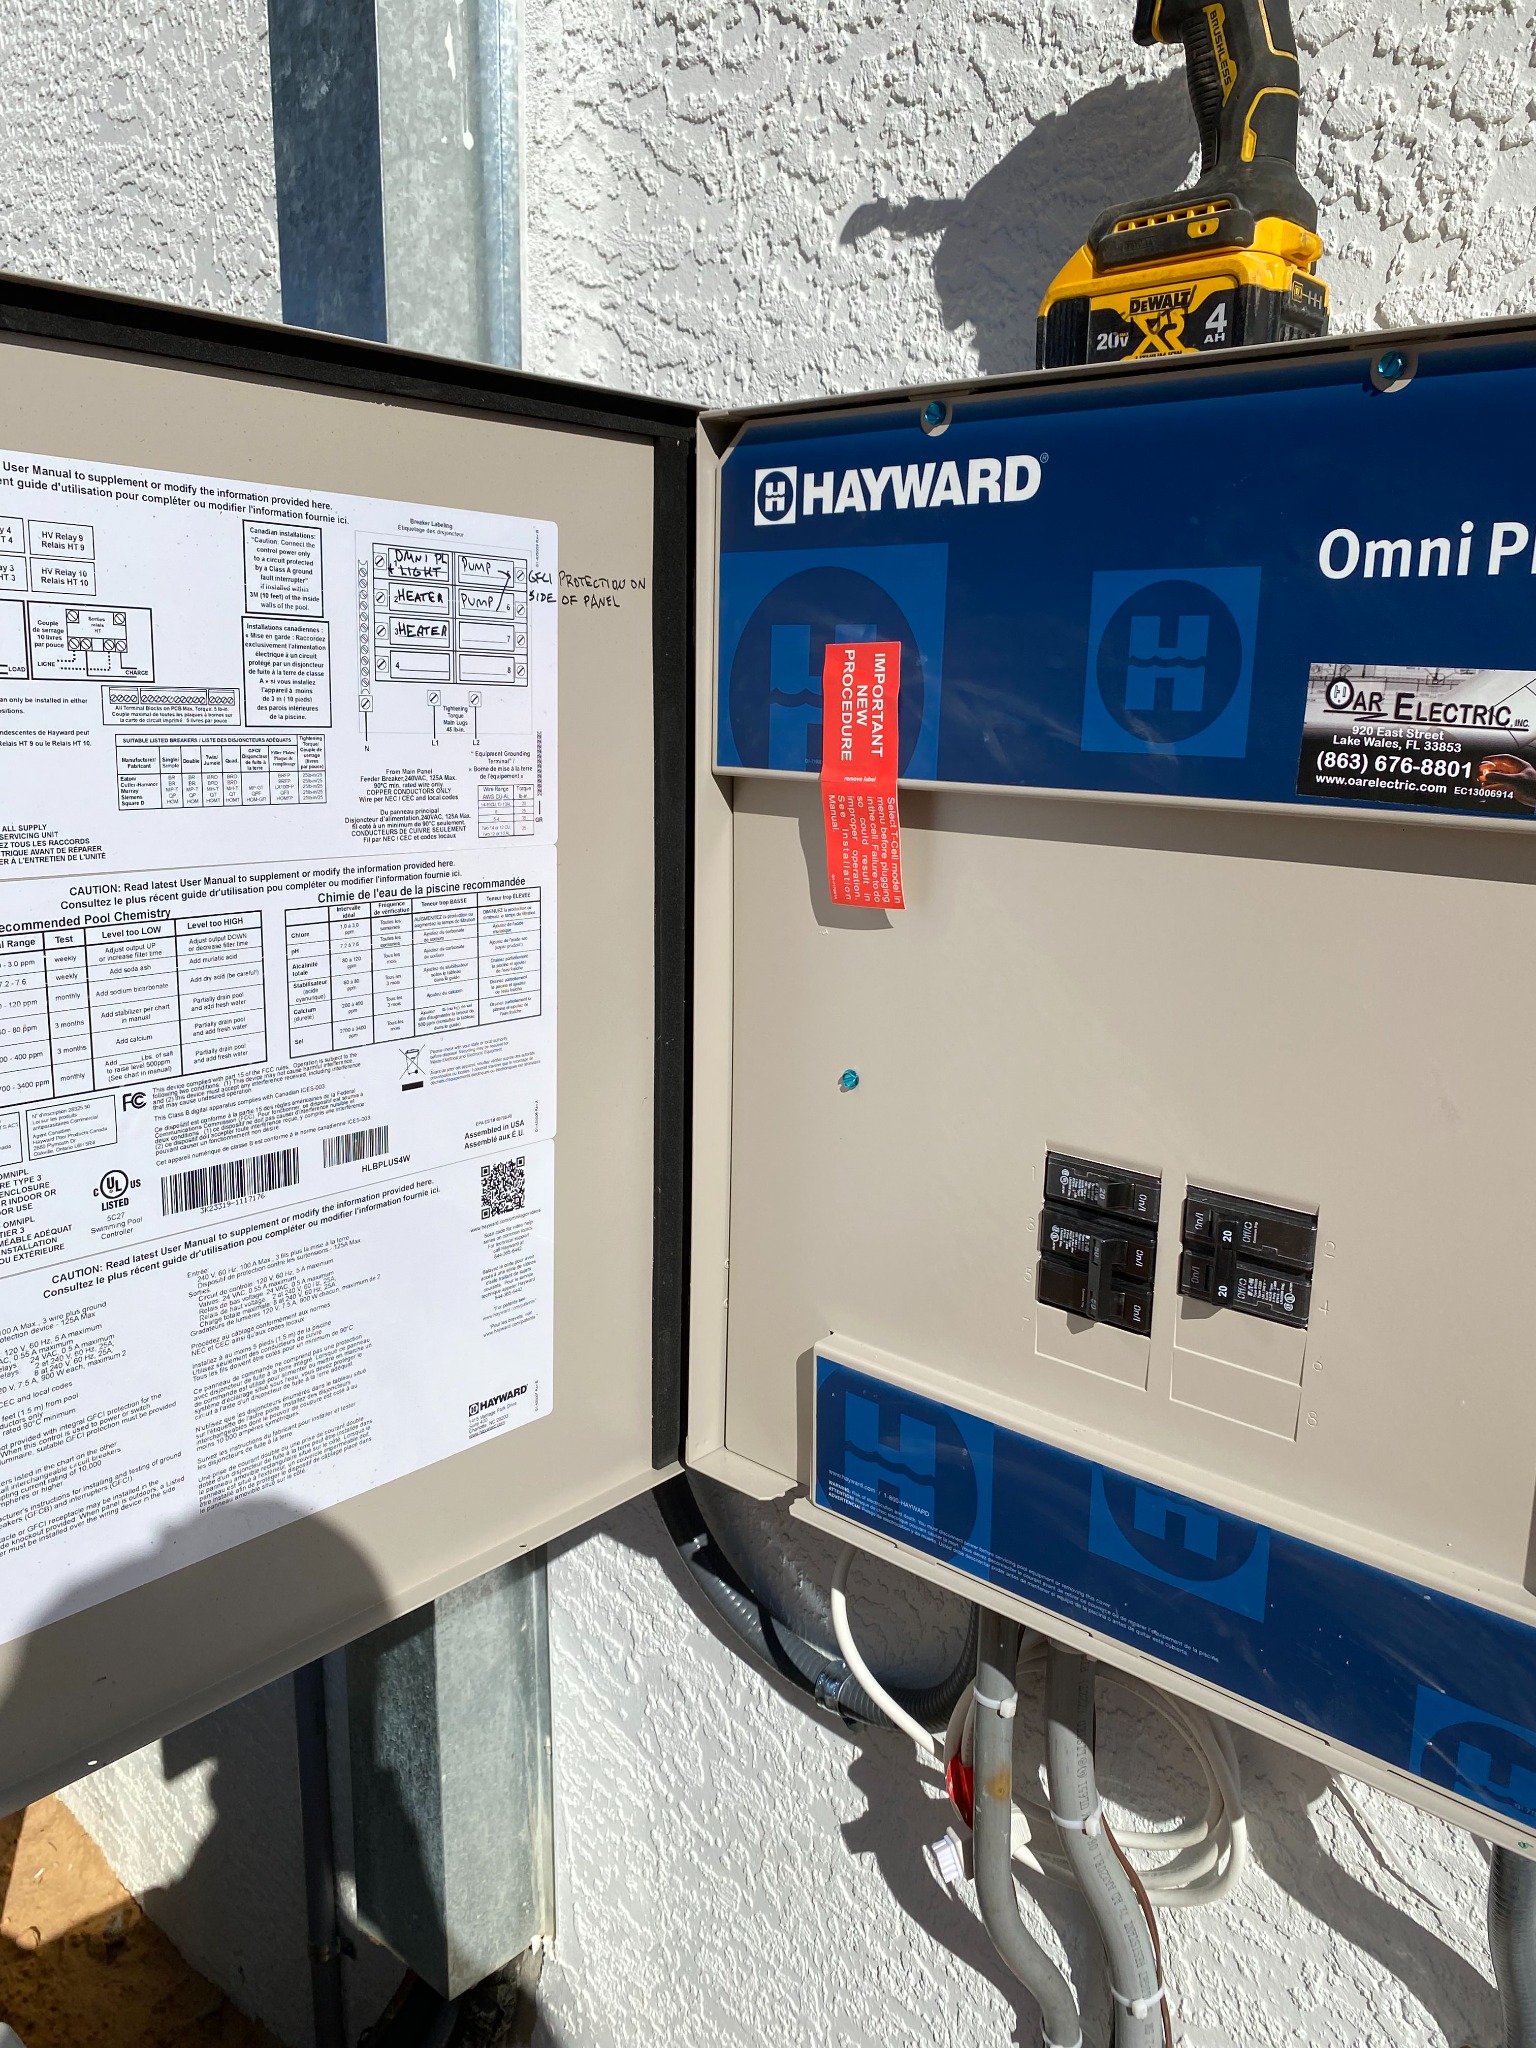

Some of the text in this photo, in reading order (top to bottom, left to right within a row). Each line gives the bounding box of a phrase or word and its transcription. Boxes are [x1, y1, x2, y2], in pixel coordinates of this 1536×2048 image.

[1209, 10, 1232, 85] BRUSHLESS
[1205, 302, 1228, 333] 4
[1130, 308, 1188, 355] XR
[1203, 332, 1226, 344] AH
[2, 460, 332, 510] User Manual to supplement or modify the information provided here.
[802, 454, 1042, 516] HAYWARD
[16, 479, 47, 490] guide
[50, 482, 112, 497] d'utilisation
[115, 491, 139, 500] pour
[141, 494, 191, 506] compléter
[193, 500, 205, 508] ou
[208, 502, 246, 513] modifier
[248, 504, 303, 519] l'information
[304, 511, 335, 522] fournie
[337, 515, 349, 524] ici.
[41, 530, 53, 539] HV
[55, 532, 77, 542] Relay
[41, 540, 84, 551] Relais HT 9
[1318, 520, 1475, 580] Omni
[41, 566, 53, 574] HV
[54, 568, 76, 578] Relay
[400, 564, 442, 578] LIGHT
[461, 556, 491, 574] PUMP
[40, 576, 65, 584] Relais
[528, 570, 646, 591] GFCI PROTECTION ON
[397, 588, 444, 604] HEATER
[460, 592, 494, 609] PUMP
[528, 590, 621, 608] SIDE OF PANEL
[398, 622, 448, 638] HEATER
[840, 649, 855, 760] PROCEDURE
[856, 684, 868, 726] NEW
[870, 653, 886, 757] IMPORTANT
[1326, 676, 1384, 713] OAR
[1514, 718, 1530, 728] INC.
[1332, 734, 1461, 752] Lake Wales, FL 33853
[1352, 726, 1445, 741] 920 East Street
[1316, 750, 1471, 778] (863) 676-8801
[1315, 774, 1446, 793] www.oarelectric.com
[1453, 786, 1513, 799] EC13006914
[828, 794, 839, 832] Manual.
[837, 795, 851, 900] See Installation
[846, 795, 860, 899] improper operation.
[856, 795, 871, 901] so could result in
[866, 795, 882, 903] in the cell. Failure to do
[876, 796, 890, 902] menu before plugging
[886, 796, 902, 904] Select T-Cell model in
[69, 883, 120, 896] CAUTION:
[123, 881, 148, 892] Read
[151, 879, 177, 889] latest
[179, 878, 201, 887] User
[203, 874, 236, 885] Manual
[237, 874, 247, 882] to
[248, 870, 299, 882] supplement
[312, 867, 340, 877] modify
[342, 866, 355, 874] the
[356, 863, 401, 873] information
[403, 860, 436, 871] provided
[60, 898, 111, 909] Consultez
[114, 896, 122, 905] le
[125, 895, 146, 906] plus
[149, 892, 178, 902] récent
[181, 889, 207, 901] guide
[209, 885, 264, 897] dr'utilisation
[266, 884, 283, 894] pou
[285, 880, 326, 891] compléter
[341, 876, 374, 886] modifier
[375, 873, 422, 883] l'information
[424, 871, 450, 879] fournie
[317, 878, 527, 903] Chimie de l'eau de la piscine recommandée
[84, 908, 172, 924] Pool Chemistry
[187, 920, 208, 929] Level
[223, 916, 243, 925] HIGH
[54, 935, 73, 943] Test
[101, 929, 124, 938] Level
[141, 925, 161, 934] LOW
[464, 1124, 502, 1140] Assembled
[510, 1119, 524, 1130] USA
[361, 1154, 410, 1172] HLBPLUS4W
[101, 1197, 129, 1211] LISTED
[1222, 1230, 1233, 1243] 20
[1218, 1285, 1228, 1298] 20
[480, 1384, 528, 1411] HAYWARD
